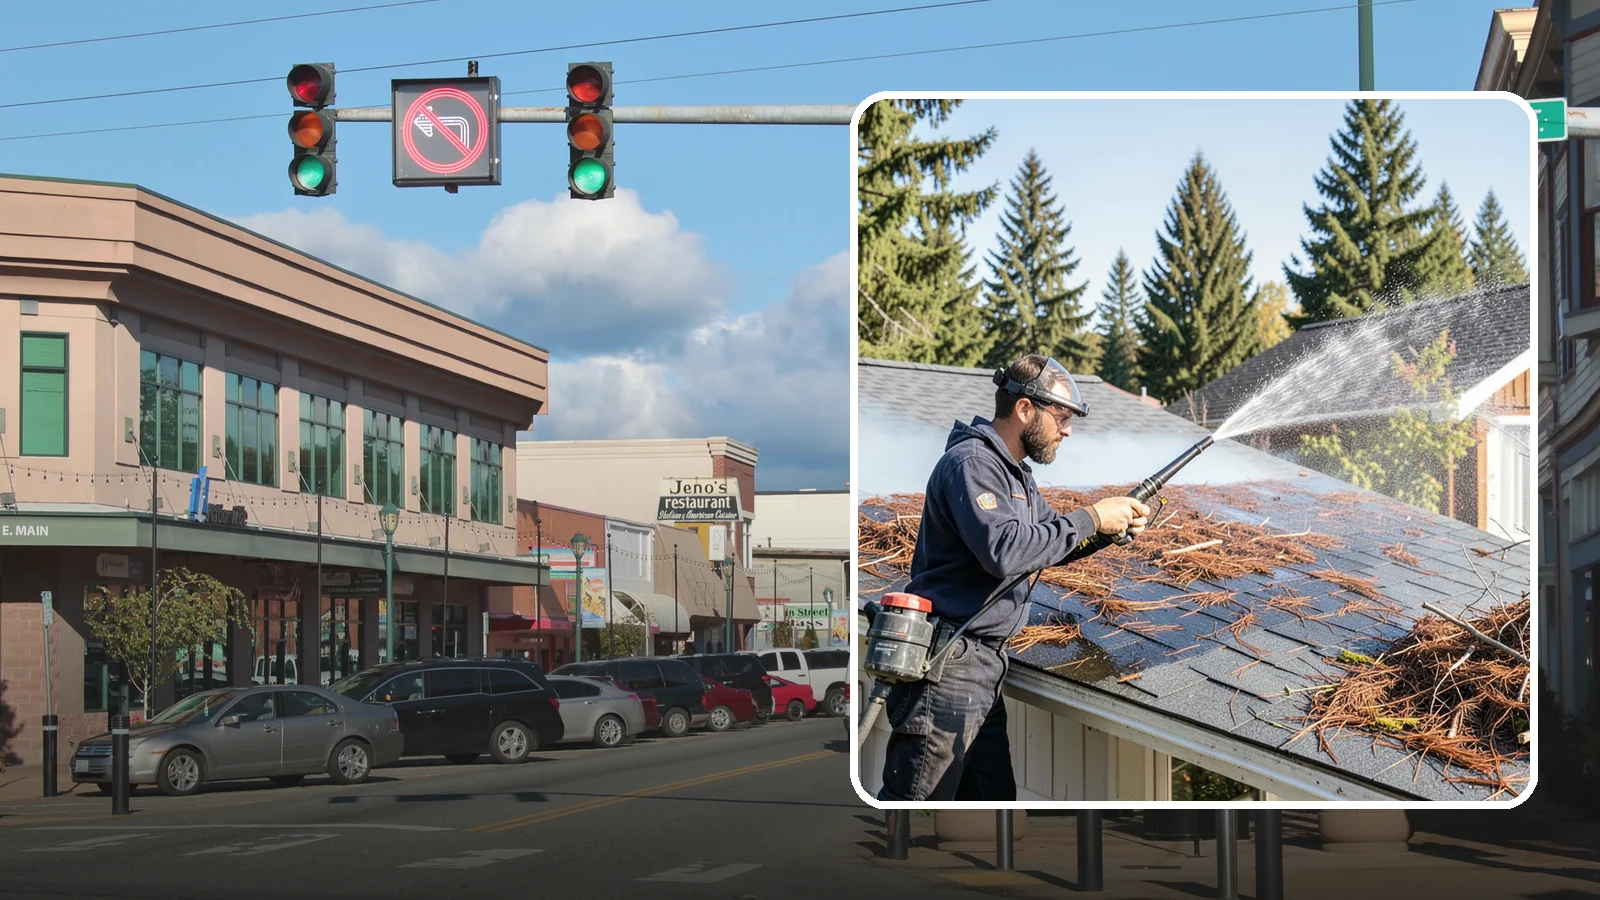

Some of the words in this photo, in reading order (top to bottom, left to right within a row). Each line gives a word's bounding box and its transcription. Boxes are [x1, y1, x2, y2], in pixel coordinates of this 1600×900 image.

[670, 480, 727, 494] Jeno's
[665, 496, 731, 509] restaurant
[658, 510, 682, 520] Italian
[686, 509, 715, 519] American
[715, 509, 738, 519] Cuisine
[2, 525, 13, 536] E.
[15, 525, 49, 536] MAIN
[797, 607, 828, 617] Street
